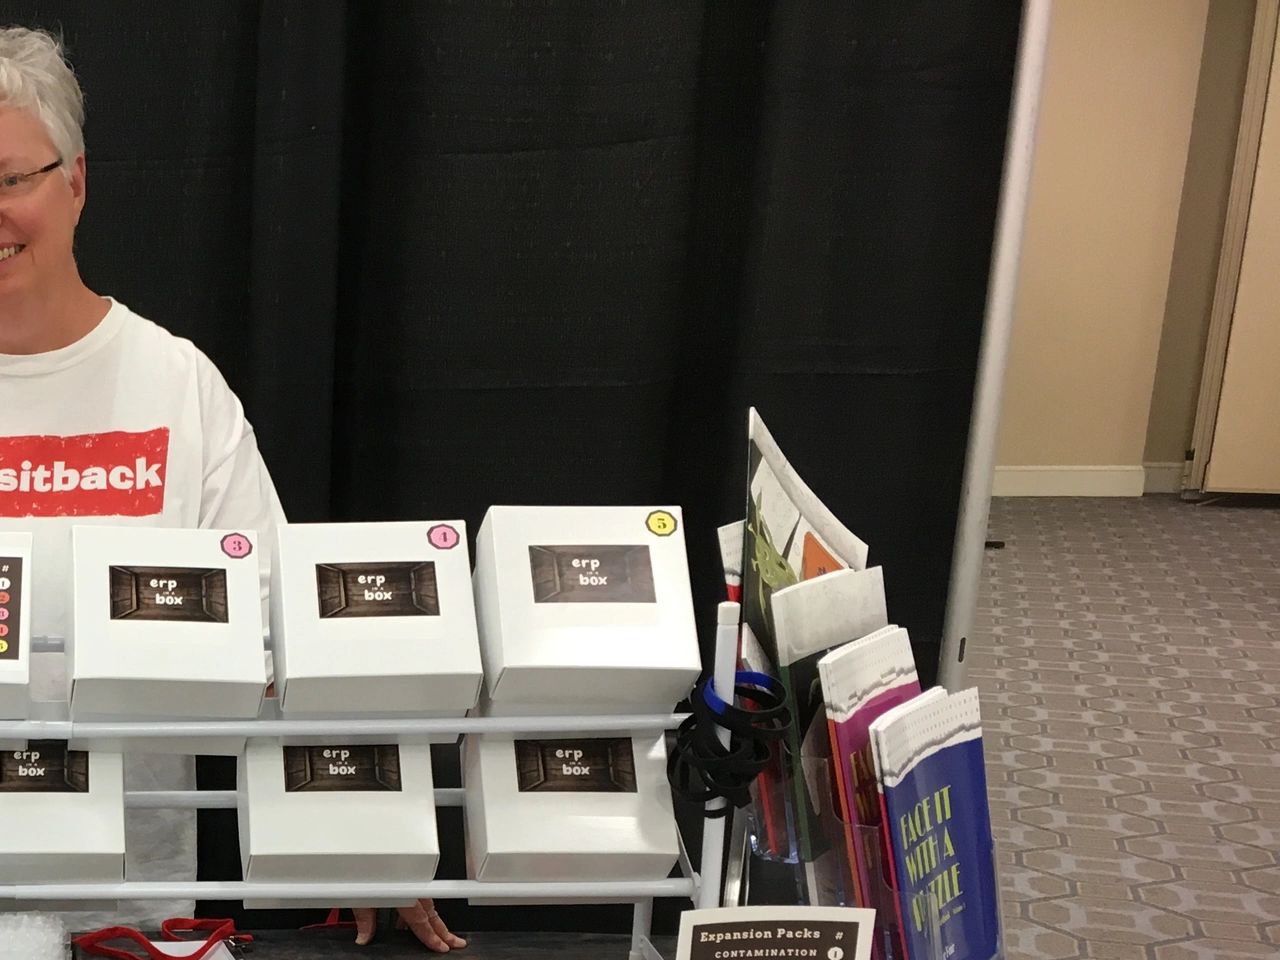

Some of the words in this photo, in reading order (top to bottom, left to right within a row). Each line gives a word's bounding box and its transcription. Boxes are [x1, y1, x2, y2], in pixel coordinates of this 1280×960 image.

[657, 518, 667, 529] 5
[233, 540, 243, 551] 3
[571, 558, 600, 570] erp
[149, 578, 177, 592] erp
[357, 574, 386, 586] erp
[579, 574, 608, 586] box
[155, 593, 183, 605] box
[364, 589, 393, 601] box
[13, 751, 40, 763] erp
[322, 749, 350, 761] erp
[555, 749, 583, 762] erp
[18, 765, 46, 776] box
[329, 763, 356, 775] box
[562, 763, 590, 775] box
[900, 795, 933, 850] FACE
[934, 784, 952, 825] IT
[904, 833, 942, 886] WITH
[942, 826, 956, 861] A
[699, 929, 773, 943] Expansion
[776, 928, 821, 939] Packs
[714, 949, 818, 959] CONTAMINATION
